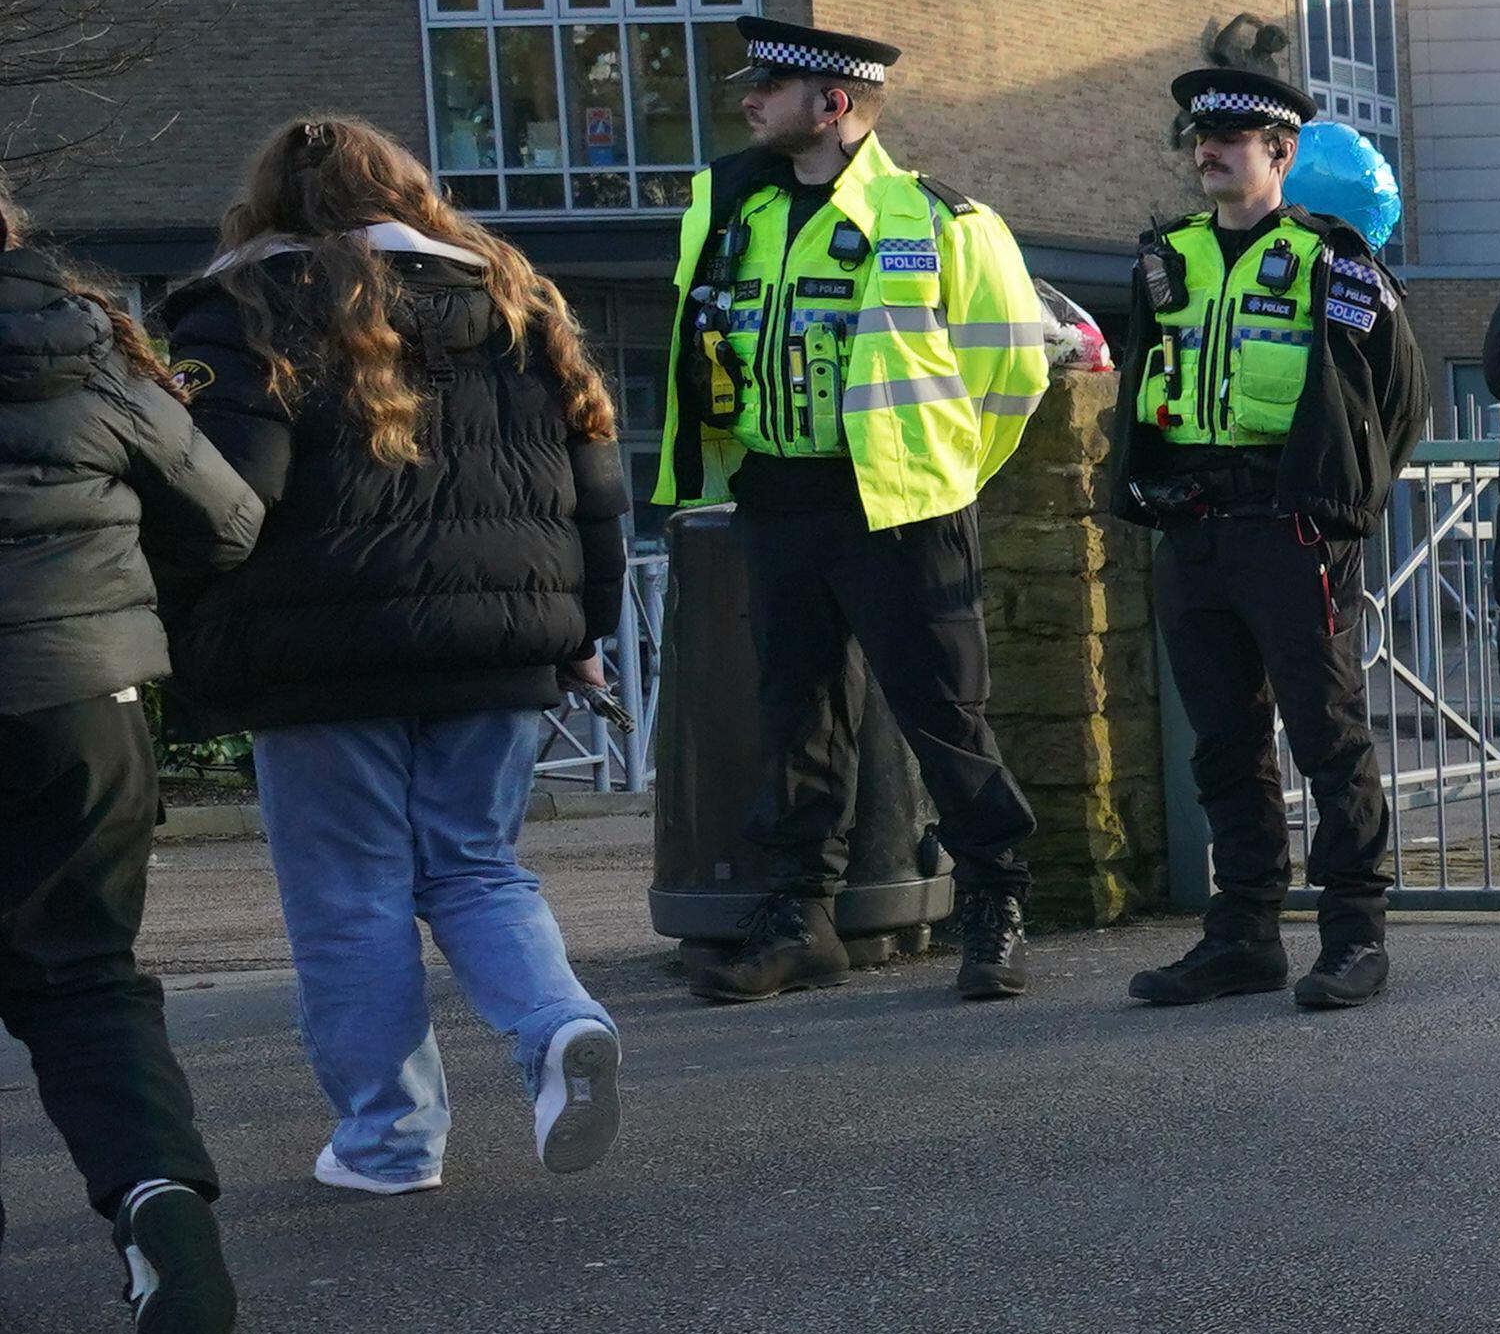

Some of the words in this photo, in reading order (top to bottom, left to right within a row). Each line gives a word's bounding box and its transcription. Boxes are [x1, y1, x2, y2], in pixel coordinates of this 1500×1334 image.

[885, 256, 935, 270] POLICE
[818, 284, 847, 294] POLICE
[1345, 288, 1372, 304] POLICE
[1262, 302, 1290, 314] POLICE
[1327, 303, 1371, 326] POLICE
